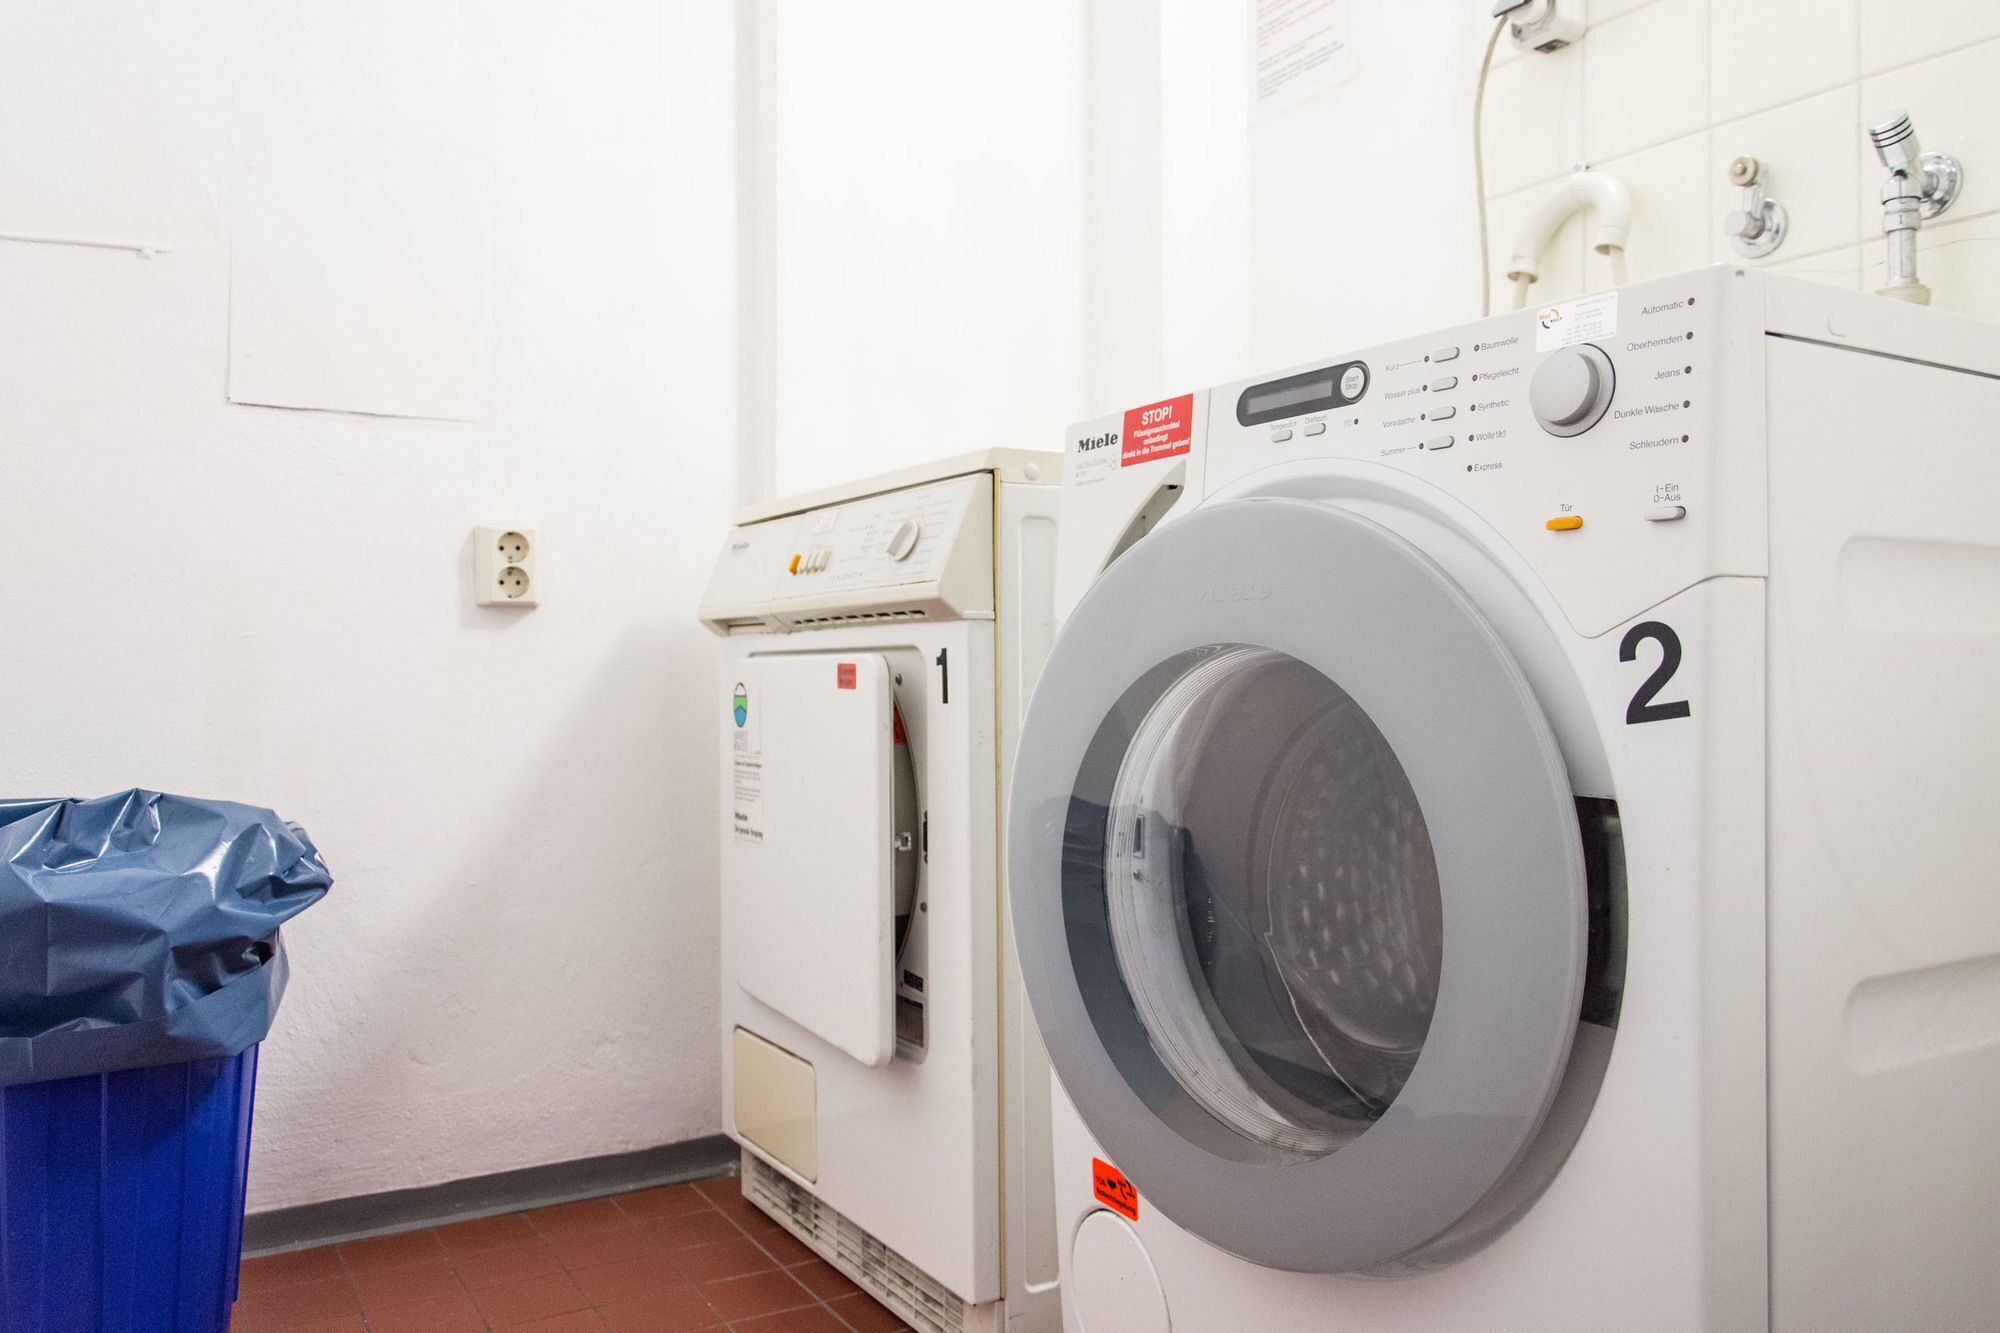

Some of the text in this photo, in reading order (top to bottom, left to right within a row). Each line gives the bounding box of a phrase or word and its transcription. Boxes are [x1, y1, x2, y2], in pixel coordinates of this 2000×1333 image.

[1641, 300, 1684, 316] Automatic
[1481, 337, 1519, 351] Baumwolle
[1626, 334, 1683, 352] Oberhemden
[1385, 363, 1400, 372] Kurz
[1479, 367, 1520, 381] Pflegeleicht
[1654, 368, 1681, 380] Jeans
[1384, 388, 1421, 400] Wasser plus
[1477, 399, 1510, 412] Synthetic
[1613, 401, 1680, 419] Dunkle Wäsche
[1142, 405, 1173, 426] STOP!
[1077, 433, 1119, 453] Miele
[1143, 433, 1169, 446] unbedingt
[1475, 432, 1496, 441] Wolle
[1629, 436, 1679, 450] Schleudern
[1122, 449, 1136, 460] direkt
[1142, 446, 1150, 455] die
[1150, 442, 1172, 454] Trommel
[1172, 437, 1191, 450] geben!
[1473, 462, 1503, 473] Express
[1560, 503, 1573, 512] Tür
[936, 647, 948, 704] 1
[1619, 621, 1691, 725] 2
